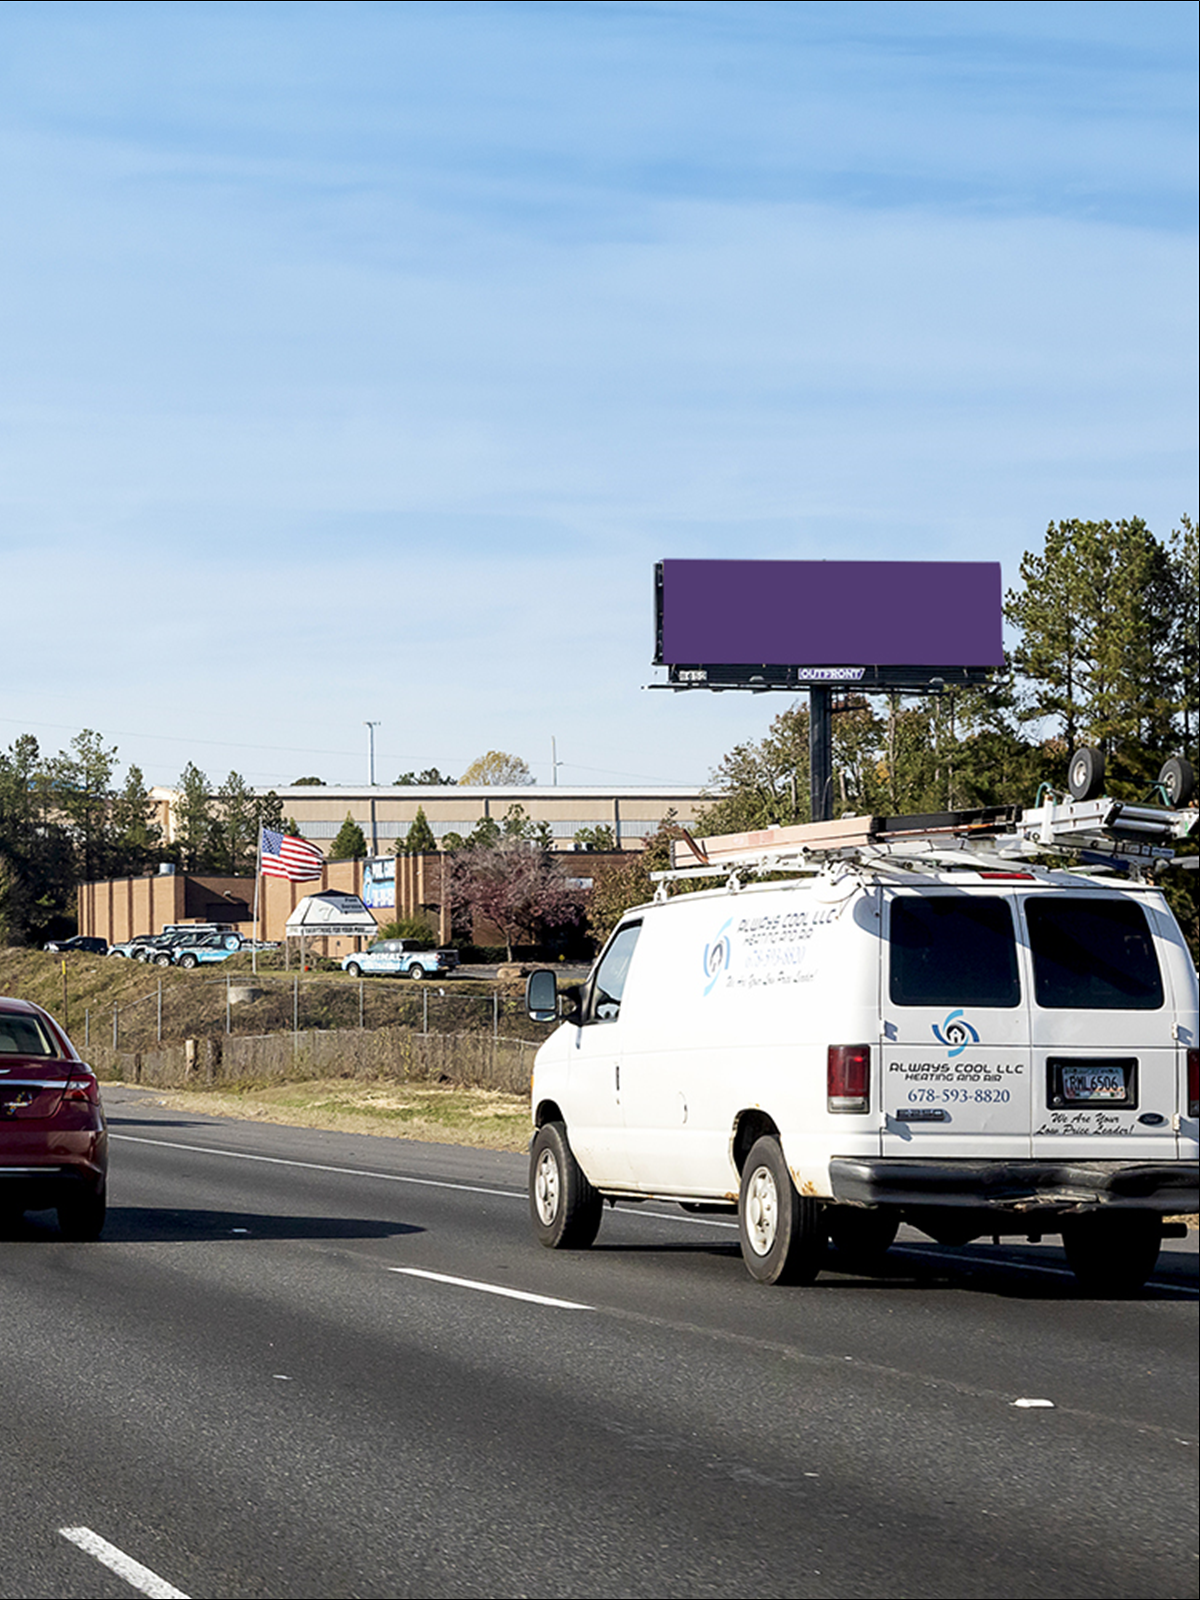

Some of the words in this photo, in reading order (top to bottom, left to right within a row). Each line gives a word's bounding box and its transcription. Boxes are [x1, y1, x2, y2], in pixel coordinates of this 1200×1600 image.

[801, 668, 863, 680] OUTFRONT
[782, 911, 809, 929] COOL
[812, 908, 837, 925] LLC
[889, 1062, 950, 1073] ALWAYS
[954, 1063, 992, 1074] COOL
[996, 1064, 1024, 1075] LLC
[905, 1073, 954, 1082] HEATING
[956, 1073, 981, 1082] AND
[984, 1074, 1002, 1082] AIR
[907, 1088, 1011, 1103] 678-593-8820
[1050, 1112, 1068, 1124] We
[1071, 1112, 1091, 1124] Are
[1095, 1112, 1120, 1126] Your
[1035, 1124, 1059, 1135] Low
[1062, 1124, 1090, 1136] Price
[1093, 1124, 1135, 1136] Leader!
